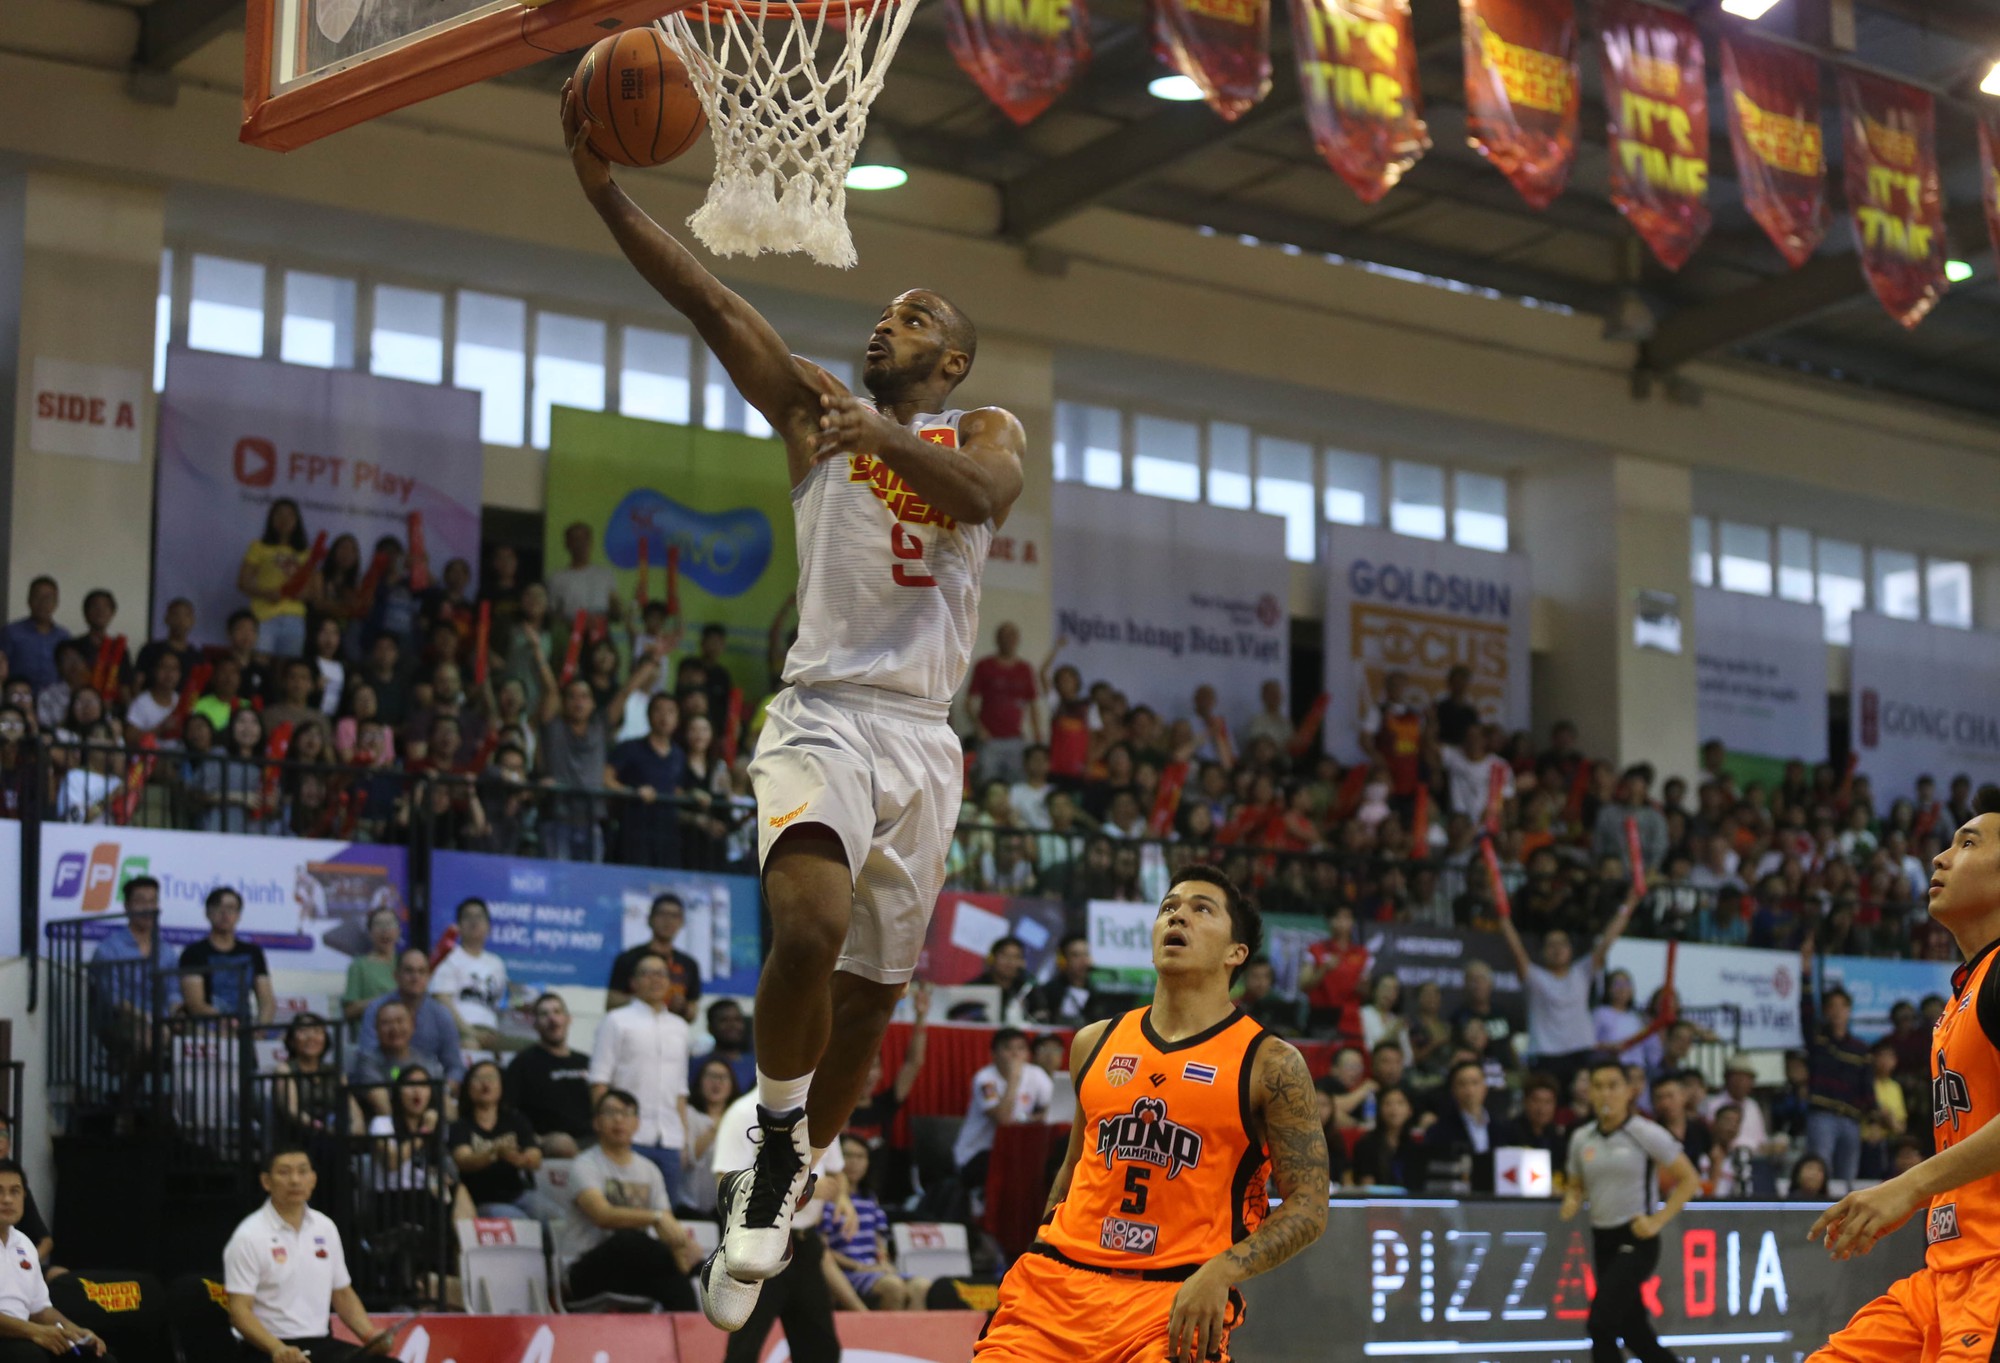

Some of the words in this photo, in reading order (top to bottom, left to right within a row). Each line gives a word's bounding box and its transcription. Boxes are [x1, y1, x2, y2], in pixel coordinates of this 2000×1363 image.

[1309, 6, 1398, 67] IT'S
[621, 68, 637, 101] FIBA
[1302, 60, 1404, 118] TIME
[1620, 88, 1694, 152] IT'S
[1617, 138, 1709, 196] TIME
[37, 391, 106, 426] SIDE
[115, 401, 136, 430] A
[287, 451, 346, 487] FPT
[352, 459, 416, 504] Play
[1349, 558, 1511, 618] GOLDSUN
[1350, 603, 1510, 680] FOCUS
[1883, 700, 1950, 742] GONG
[1097, 916, 1153, 950] Forb
[1111, 1058, 1135, 1070] ABL
[1096, 1108, 1203, 1177] MONO
[1118, 1147, 1166, 1166] VAMPIRE
[1120, 1166, 1151, 1215] 5
[1126, 1226, 1155, 1250] 29
[1940, 1210, 1954, 1235] 29
[79, 1278, 140, 1300] SAIGON
[1371, 1229, 1598, 1323] PIZZA
[98, 1298, 140, 1312] HEAT
